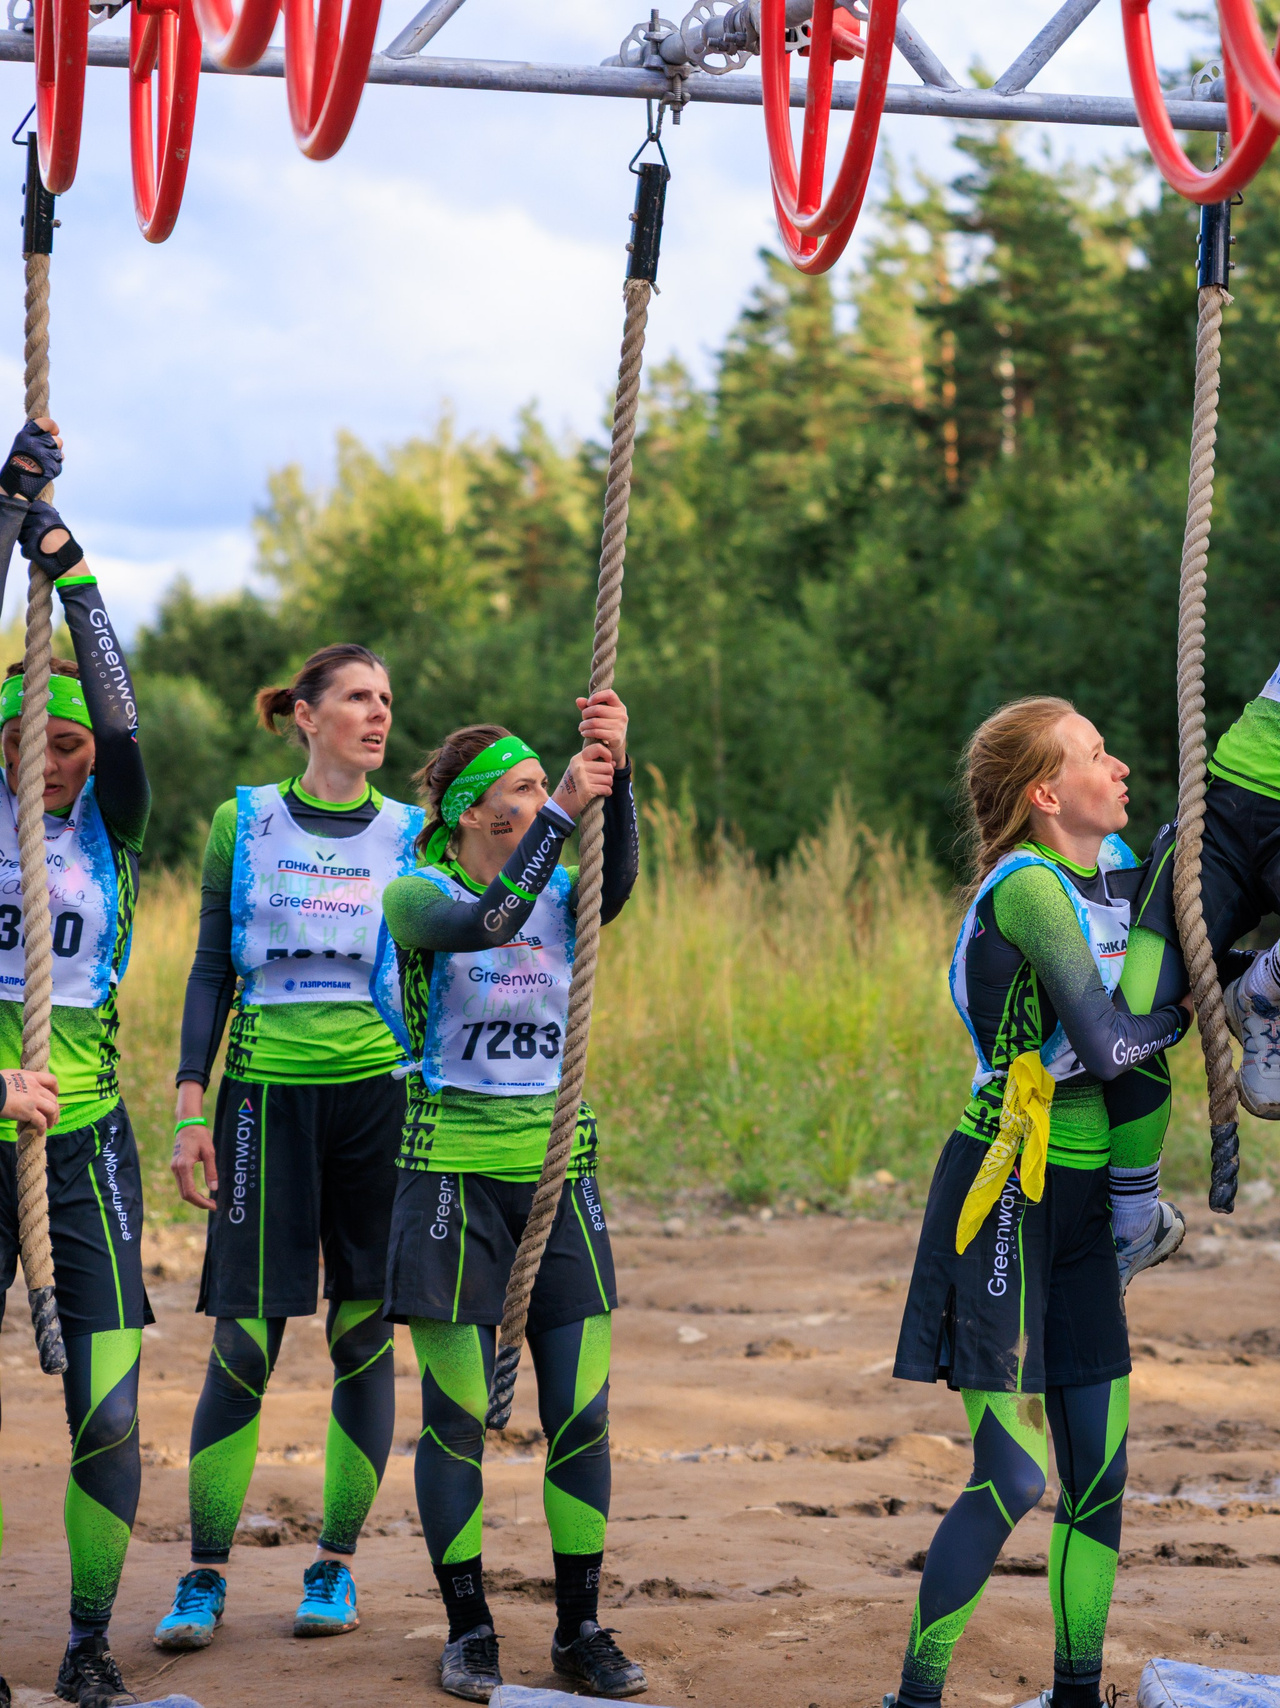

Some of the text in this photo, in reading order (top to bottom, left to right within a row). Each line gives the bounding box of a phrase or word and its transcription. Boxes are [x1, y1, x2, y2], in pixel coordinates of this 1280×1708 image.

[89, 608, 139, 731] Greenway
[90, 651, 119, 712] GLOBAL
[277, 859, 371, 878] ГОНКА ГЕРОЕВ
[269, 893, 360, 918] Greenway
[297, 911, 340, 920] GLOBAL
[299, 981, 352, 990] ГАЗПРОМБАНК
[468, 966, 554, 988] Greenway
[460, 1020, 562, 1061] 7283
[229, 1113, 255, 1225] Greenway
[987, 1180, 1021, 1297] Greenway
